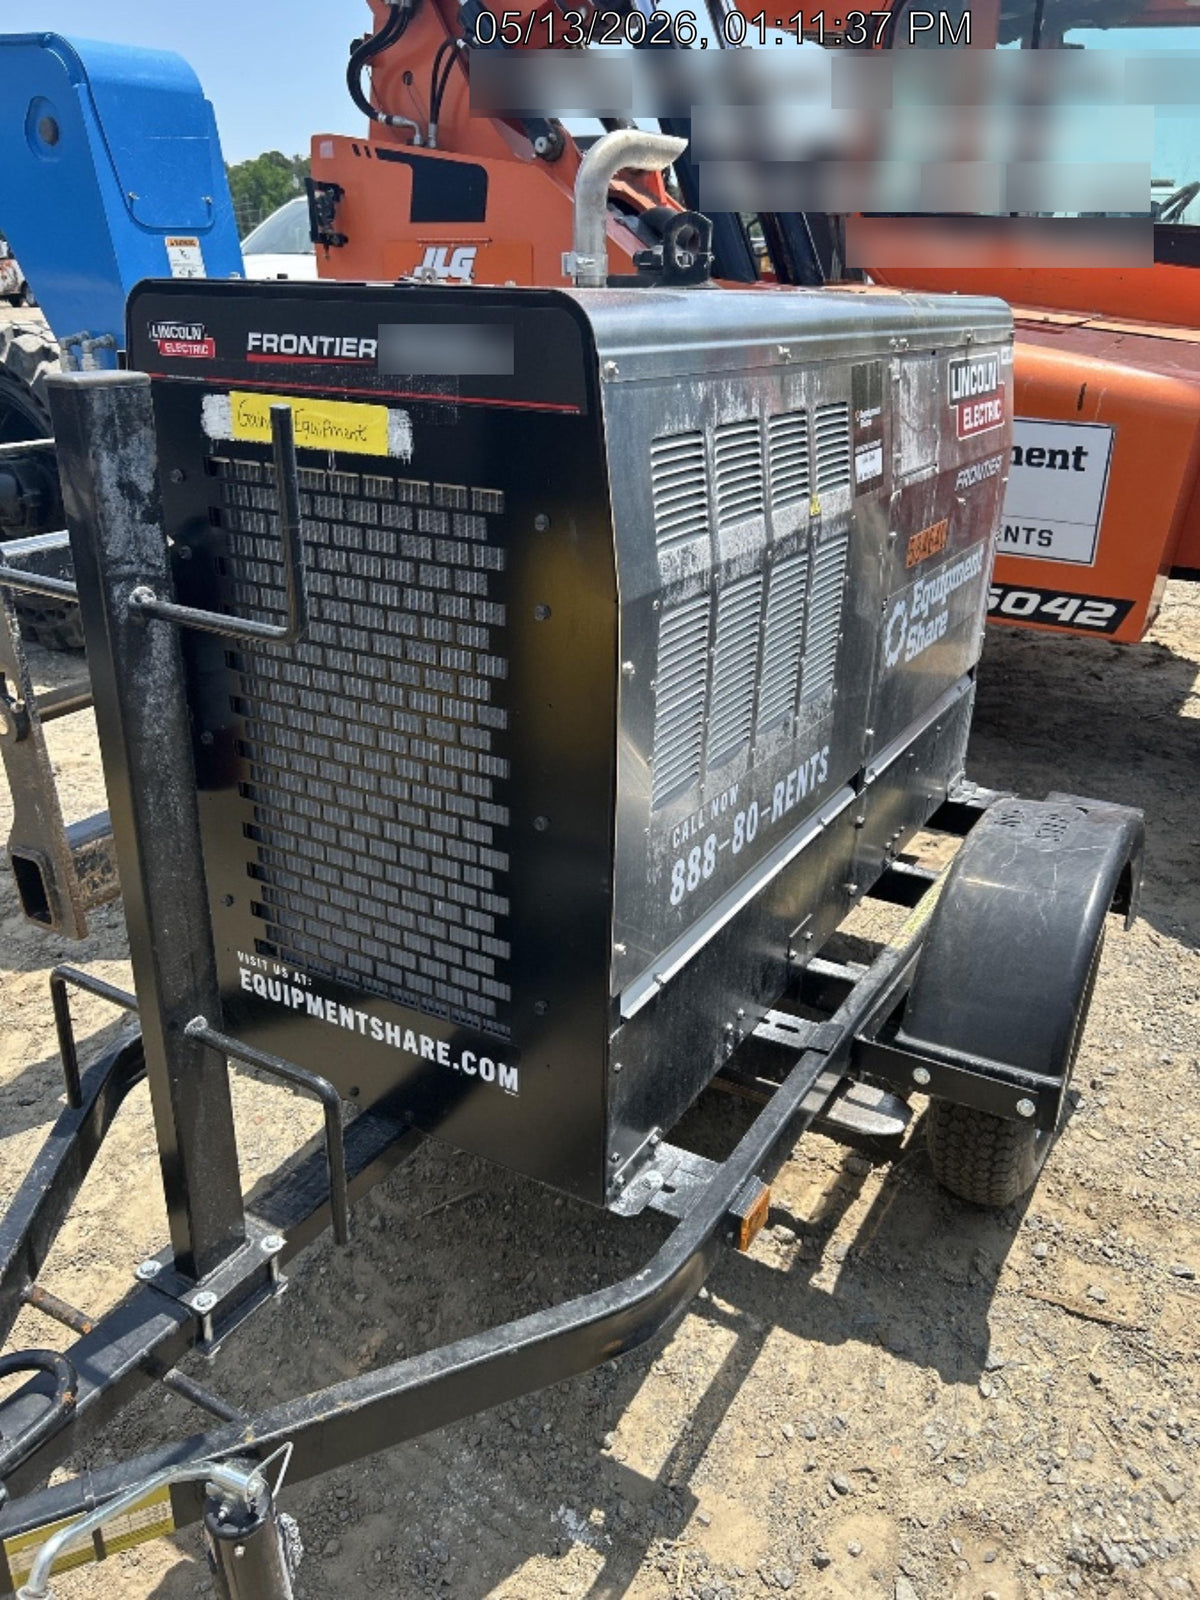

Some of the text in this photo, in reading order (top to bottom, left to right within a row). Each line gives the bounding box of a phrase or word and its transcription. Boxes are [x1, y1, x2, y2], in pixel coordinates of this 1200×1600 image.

[413, 246, 478, 280] JLG
[151, 324, 202, 340] LINCOLN
[164, 342, 209, 355] ELECTRIC
[248, 332, 378, 358] FRONTIER
[951, 361, 997, 399] LINCOLN
[963, 398, 1002, 431] ELECTRIC
[911, 543, 984, 619] Equipment
[904, 610, 949, 663] Share
[669, 745, 830, 906] 888-80-RENTS
[672, 783, 739, 849] CALL NOW
[237, 950, 312, 986] VISIT US AT:
[239, 967, 519, 1092] EQUIPMENTSHARE.COM
